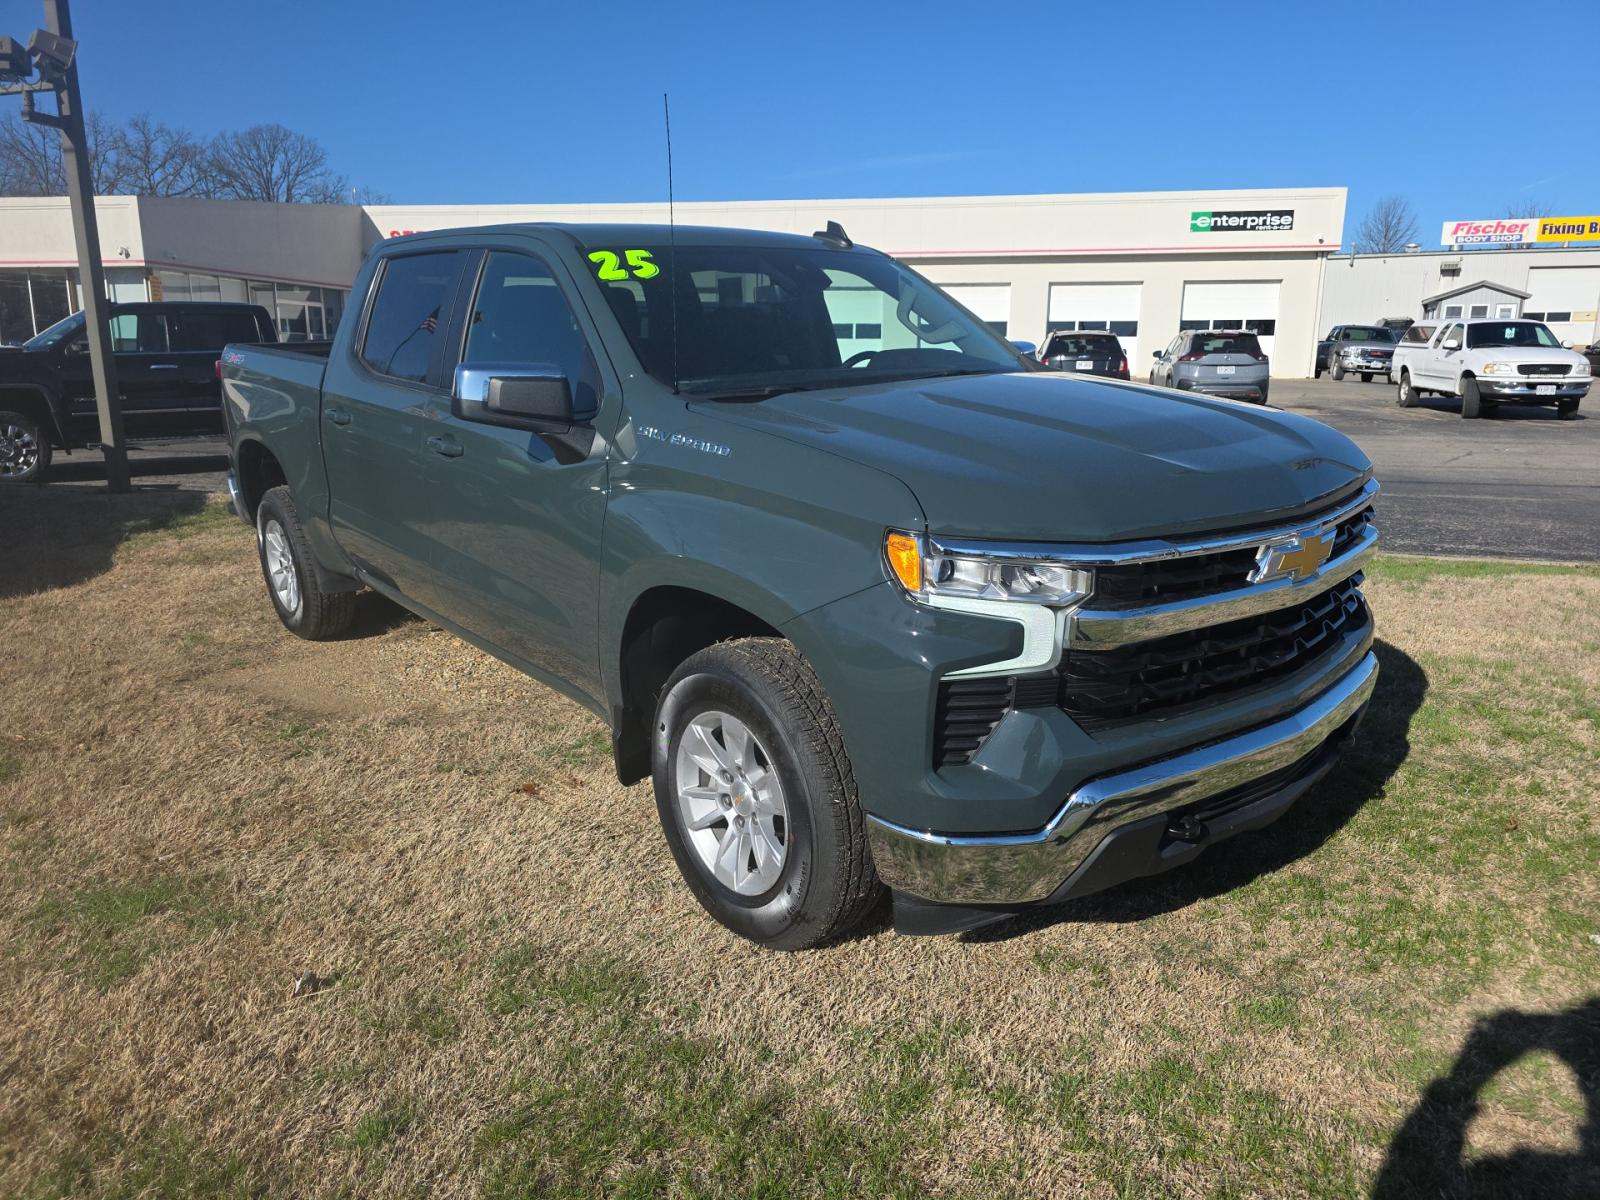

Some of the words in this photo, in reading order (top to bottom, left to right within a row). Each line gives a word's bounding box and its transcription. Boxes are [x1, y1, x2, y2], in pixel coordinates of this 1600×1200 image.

[1191, 213, 1293, 229] enterprise
[1452, 221, 1530, 235] Fischer
[1541, 222, 1585, 235] Fixing
[1589, 221, 1600, 233] B
[1457, 235, 1488, 243] BODY
[1489, 234, 1521, 242] SHOP
[587, 249, 660, 280] 25
